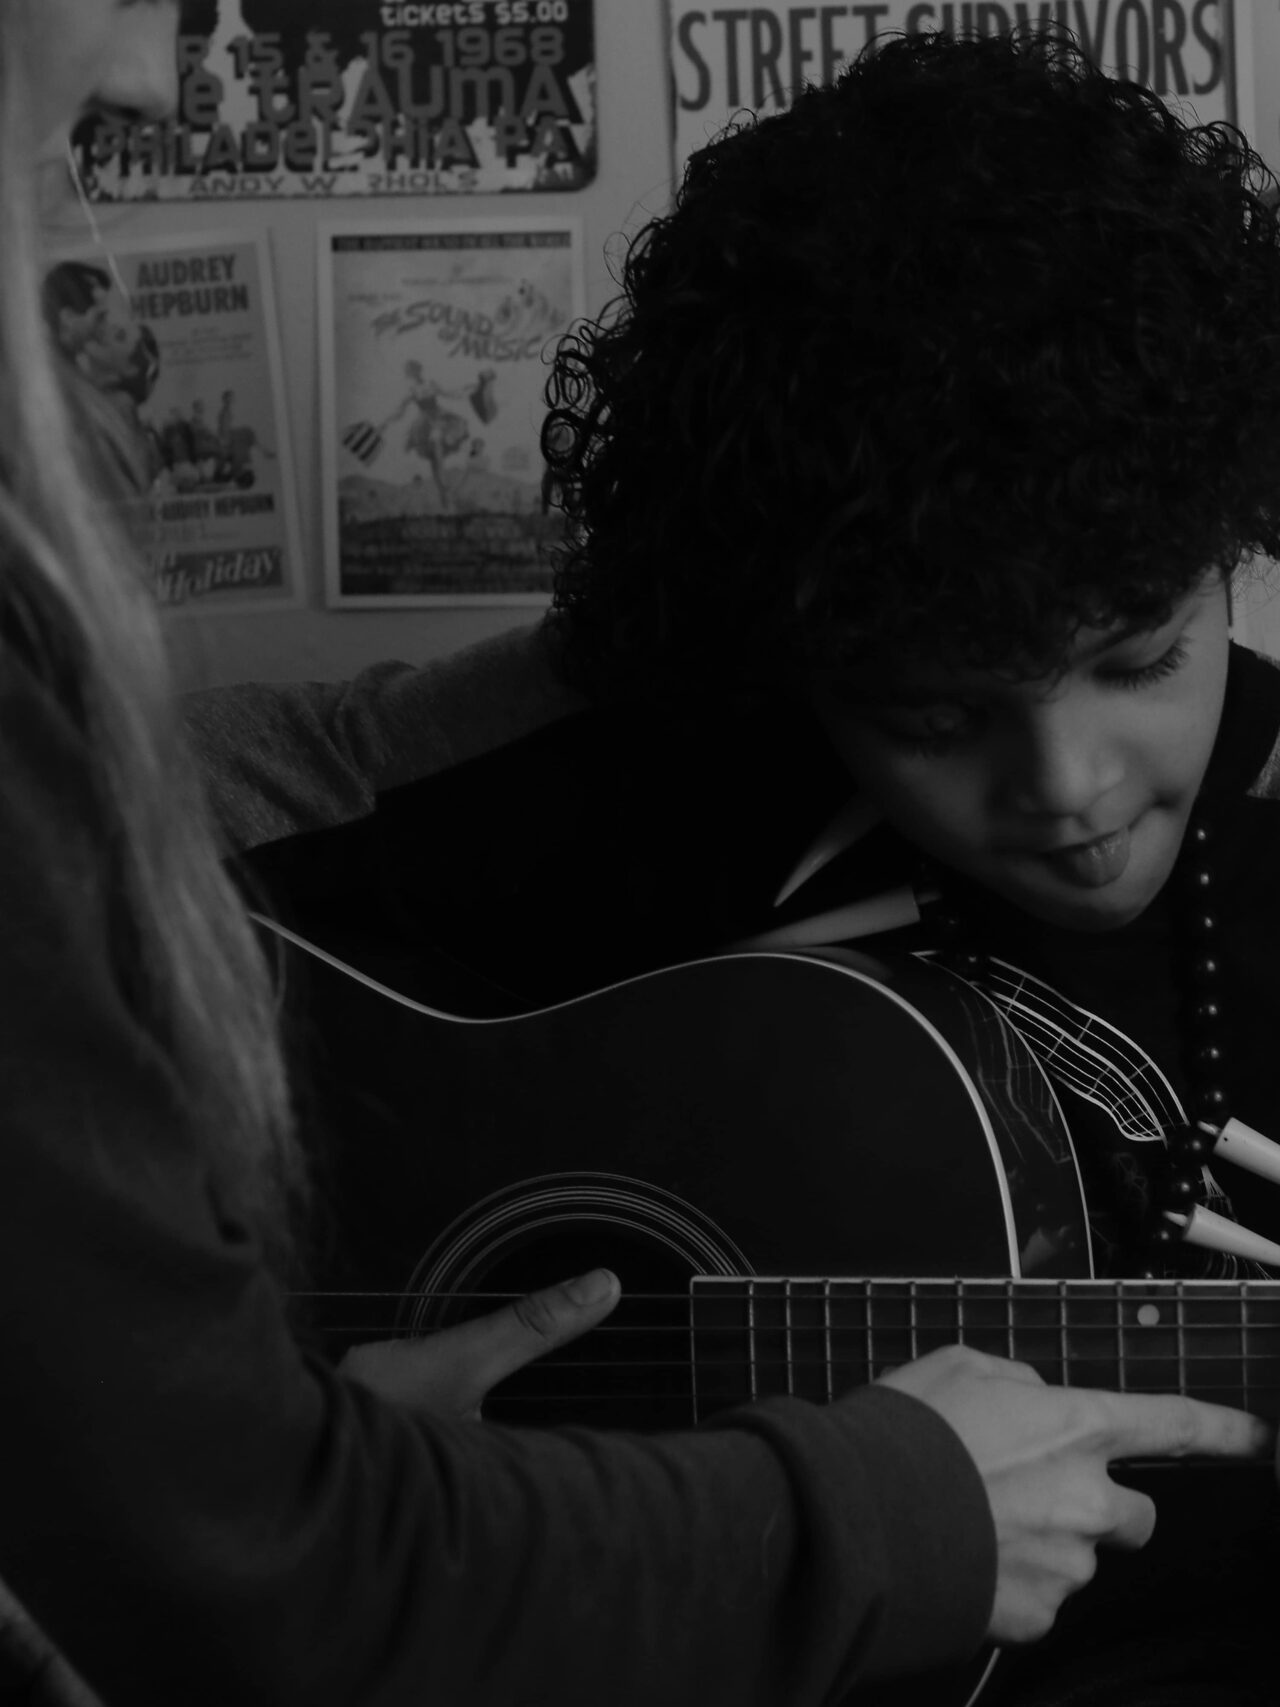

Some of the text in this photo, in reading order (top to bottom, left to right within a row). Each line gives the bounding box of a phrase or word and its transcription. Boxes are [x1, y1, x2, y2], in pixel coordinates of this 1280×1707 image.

[381, 0, 486, 27] tickets
[360, 29, 415, 70] 16
[434, 26, 565, 67] 1968
[188, 173, 284, 195] ANDY
[138, 253, 237, 289] AUDREY
[130, 284, 250, 320] HEPBURN
